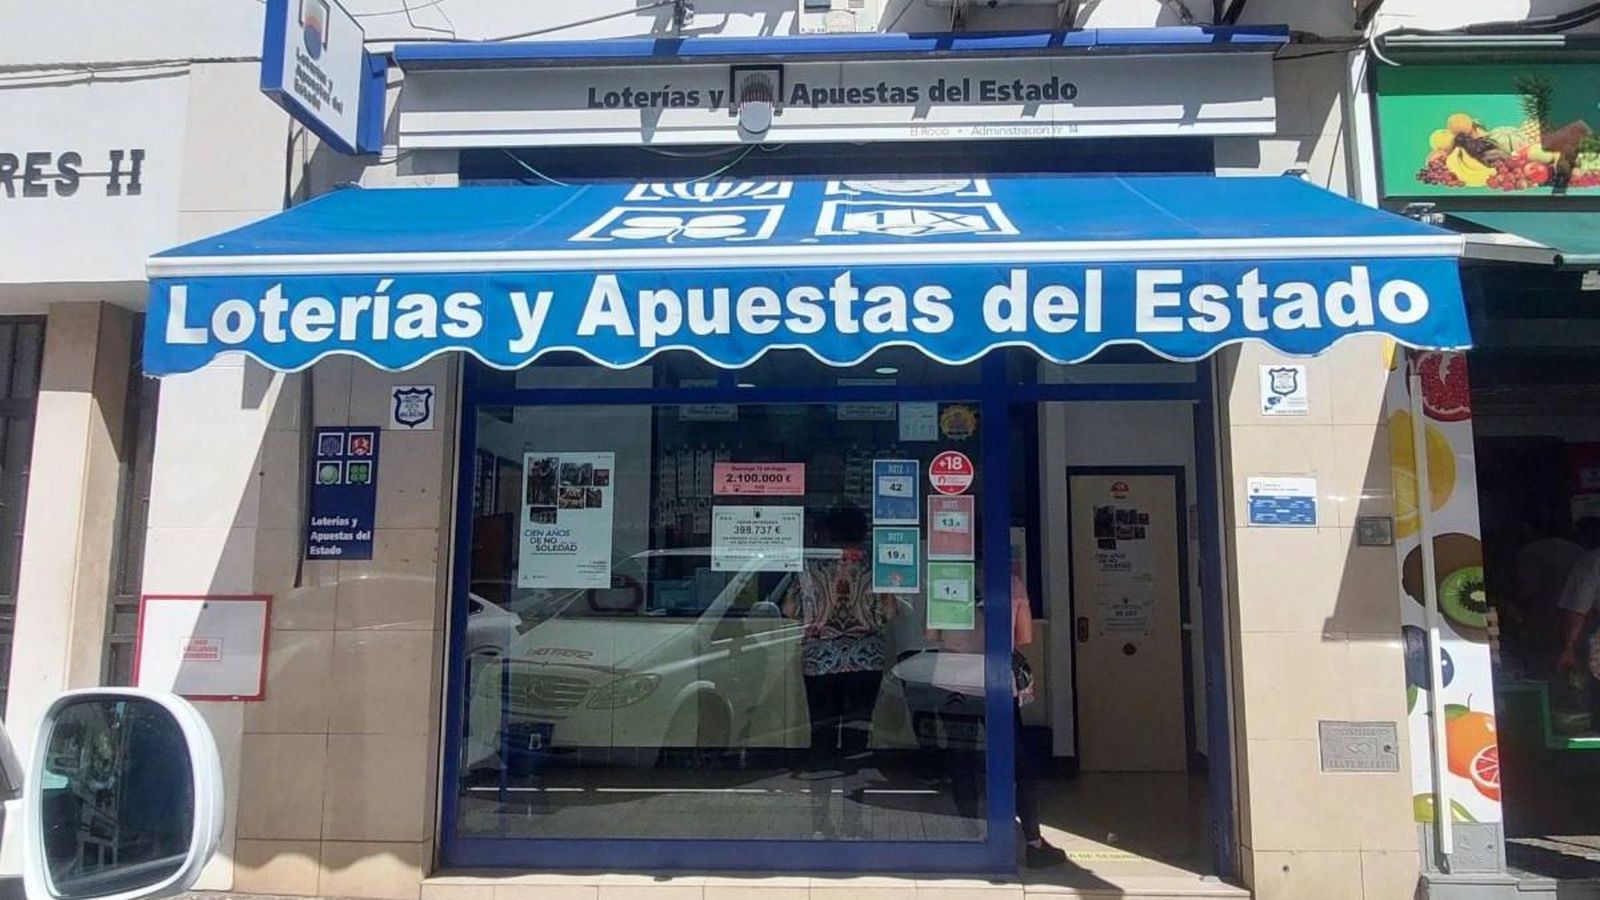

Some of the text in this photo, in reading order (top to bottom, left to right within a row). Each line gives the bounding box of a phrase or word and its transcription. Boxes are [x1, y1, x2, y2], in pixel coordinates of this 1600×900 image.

[790, 76, 1078, 108] Apuestas del Estado
[588, 85, 724, 112] Loterías y
[165, 265, 1430, 354] Loterías y Apuestas del Estado
[938, 456, 963, 470] +18
[726, 474, 793, 483] 2.100.000 €
[889, 483, 903, 491] 42
[351, 517, 358, 527] y
[734, 525, 782, 535] 398.737 €
[310, 530, 371, 543] Apuestas del
[309, 545, 342, 555] Estado
[535, 544, 578, 552] SOLEDAD
